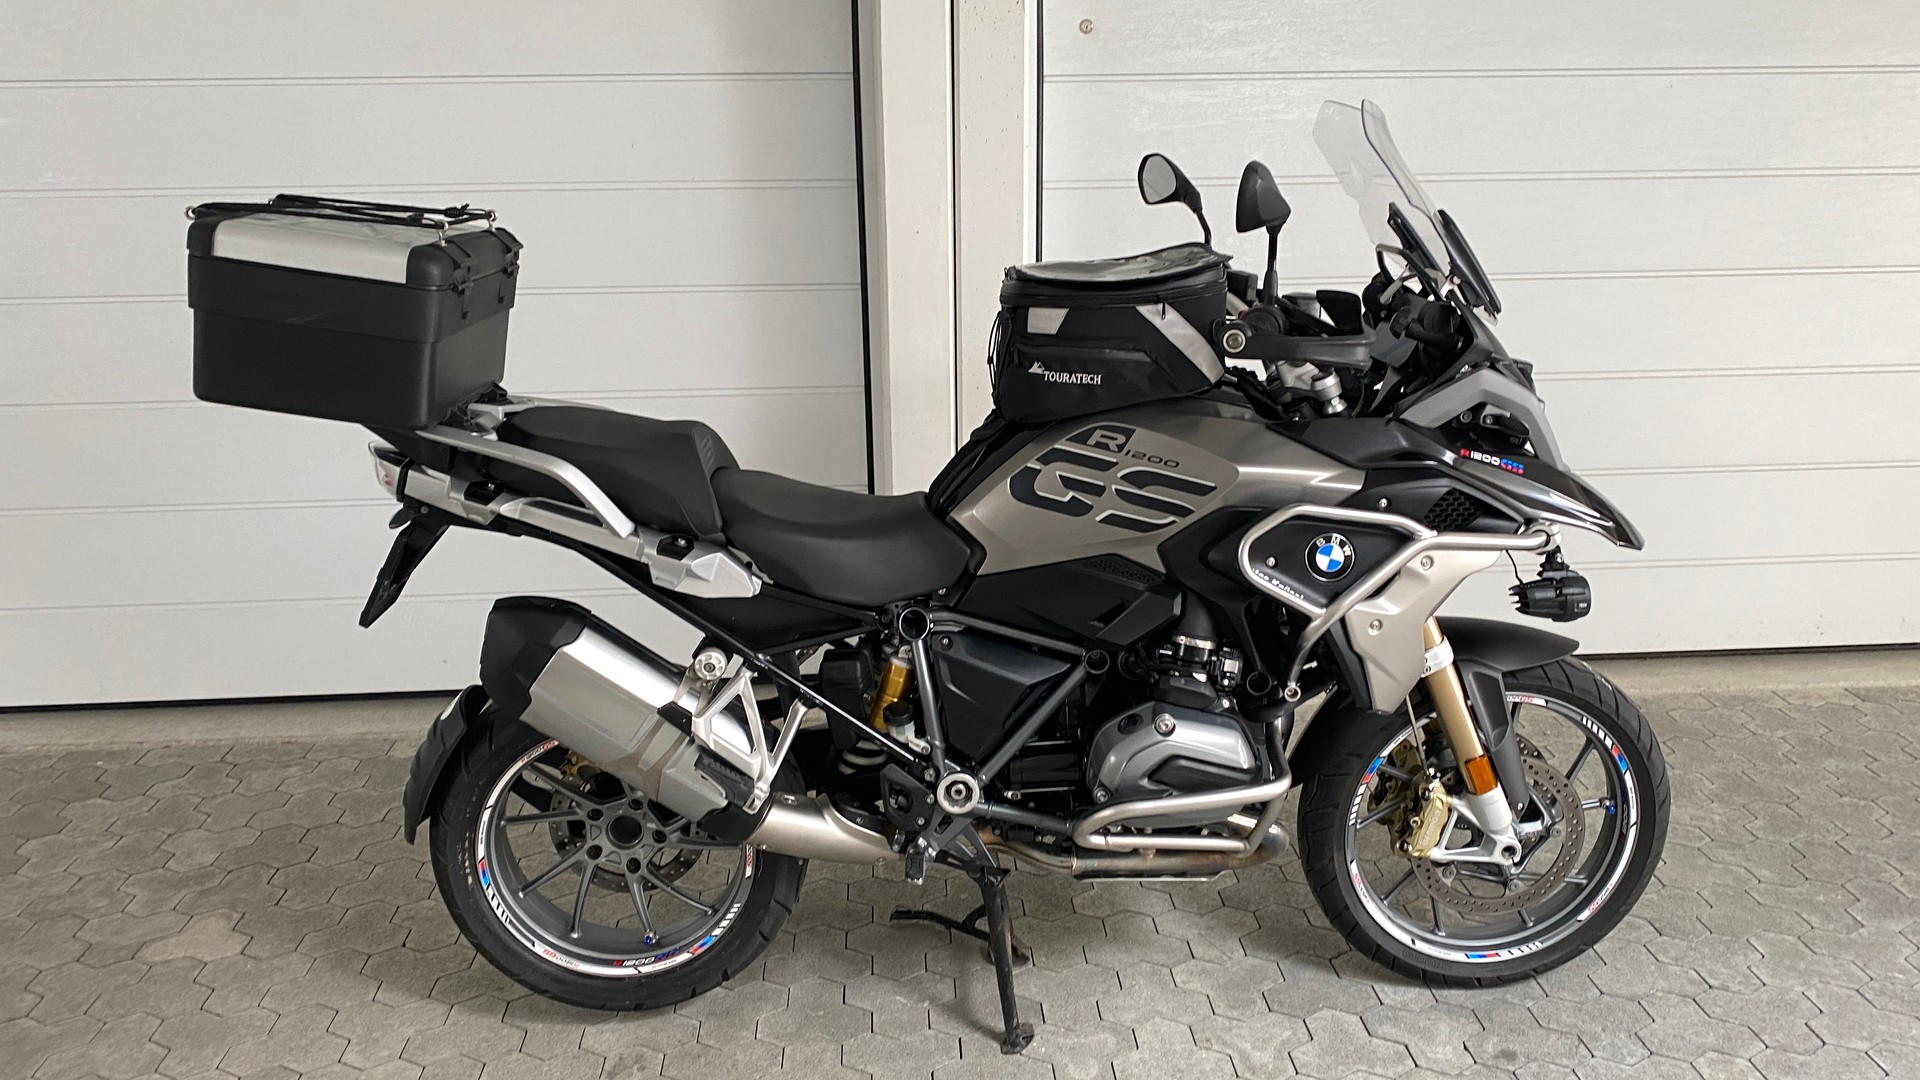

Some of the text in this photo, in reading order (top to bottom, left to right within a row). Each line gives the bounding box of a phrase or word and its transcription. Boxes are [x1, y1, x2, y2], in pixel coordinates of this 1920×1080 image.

[1043, 370, 1102, 385] TOURATECH
[1086, 428, 1180, 469] R 1200
[1006, 444, 1218, 534] GS
[1315, 533, 1352, 556] BMW
